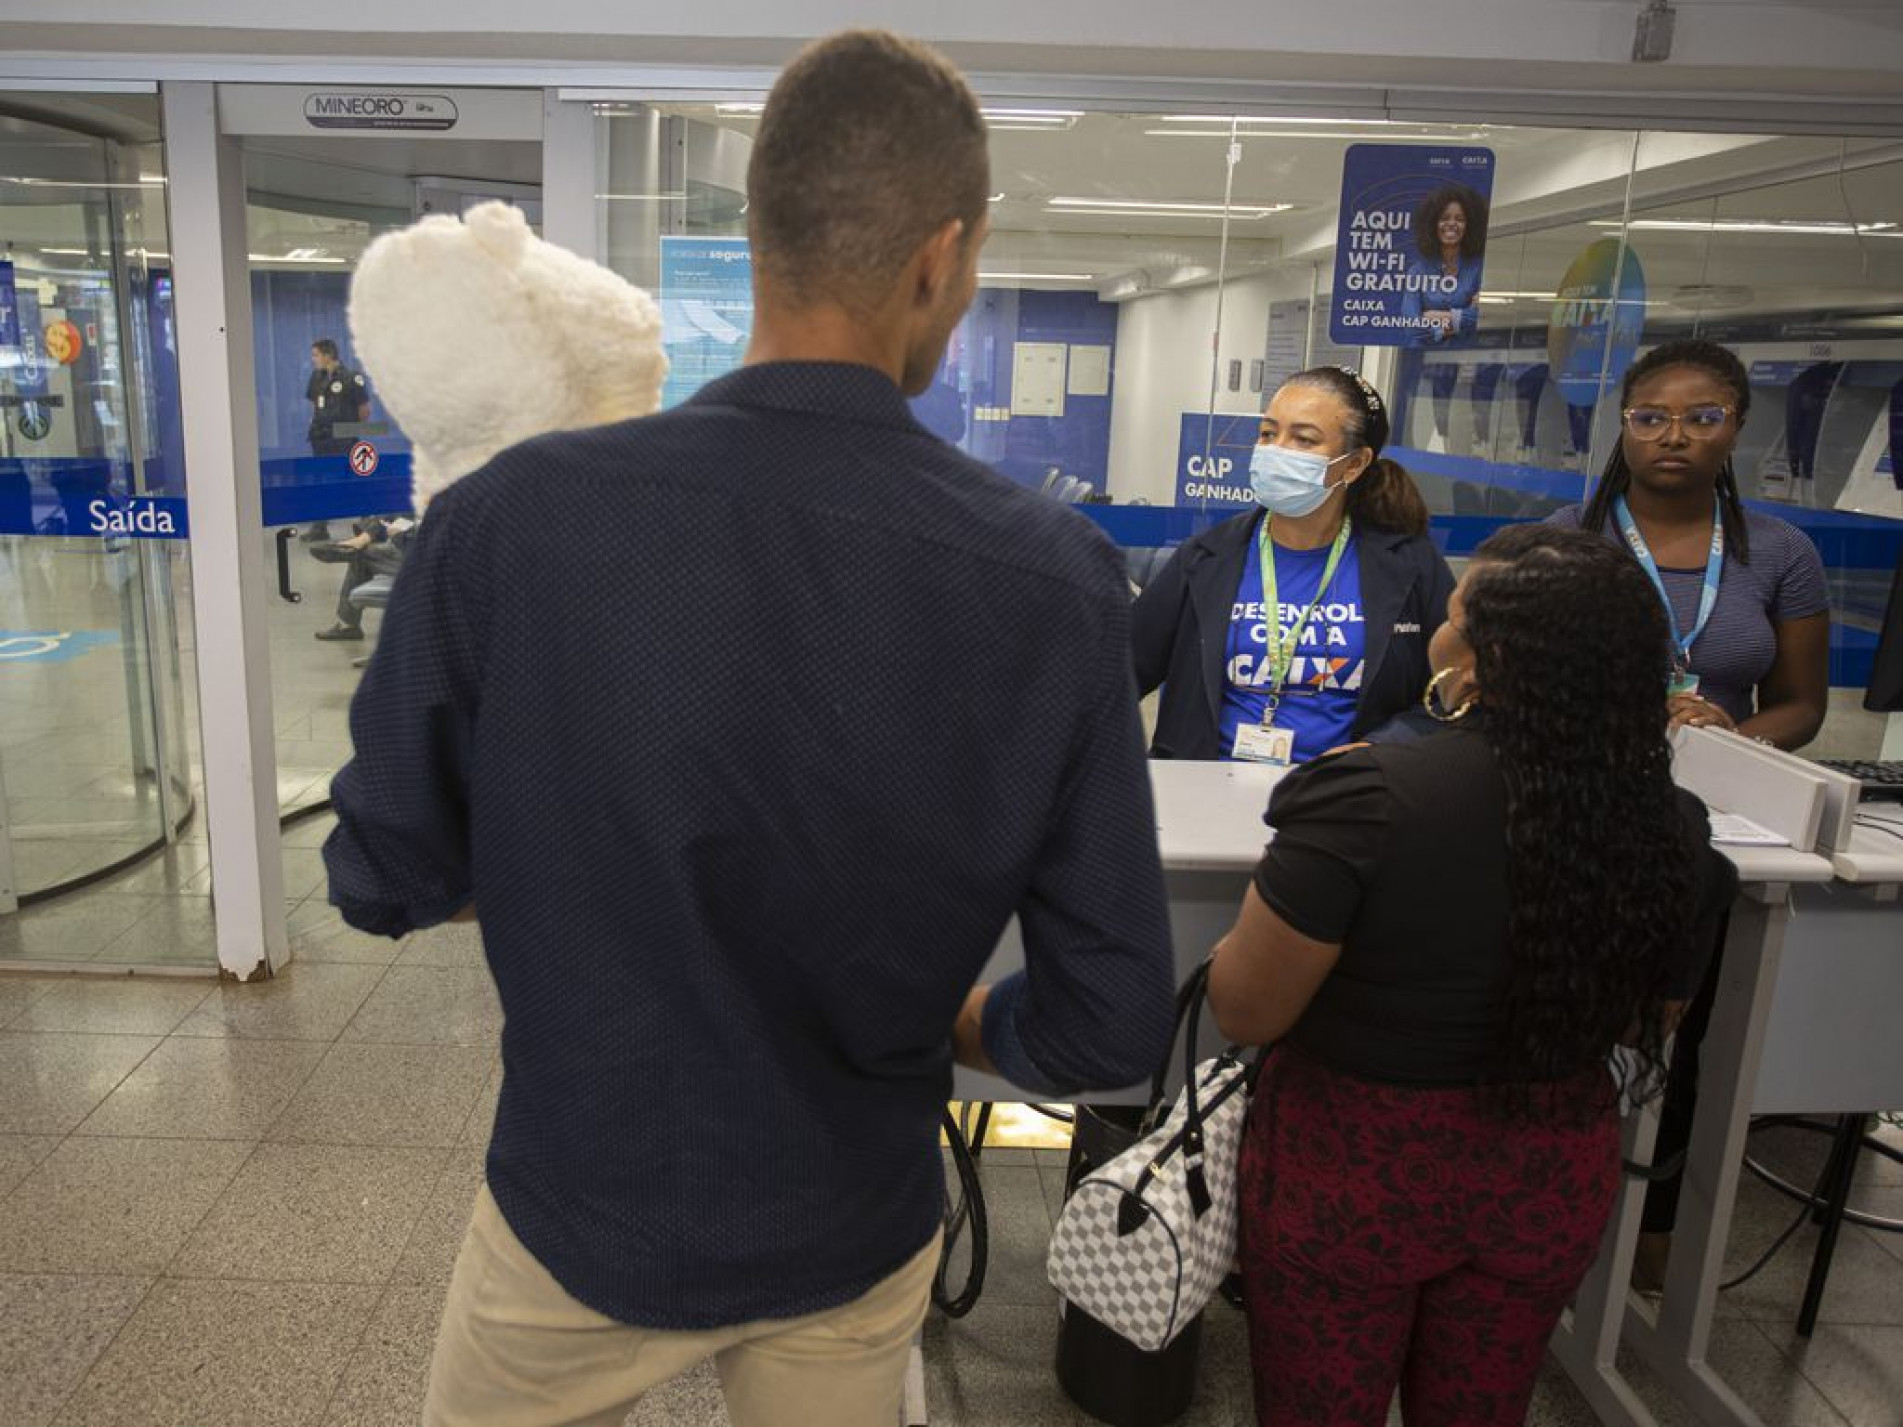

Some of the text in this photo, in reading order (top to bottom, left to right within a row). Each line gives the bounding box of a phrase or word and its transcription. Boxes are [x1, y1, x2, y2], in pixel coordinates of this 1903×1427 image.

[315, 98, 404, 115] MINEORO
[1351, 210, 1412, 231] AQUI
[1350, 231, 1393, 250] TEM
[1349, 252, 1406, 271] WI-FI
[1346, 273, 1458, 293] GRATUITO
[1343, 299, 1385, 311] CAIXA
[1342, 315, 1450, 328] CAP GANHADOR
[1187, 455, 1233, 478] CAP
[1185, 482, 1261, 502] GANHAD
[89, 500, 175, 533] Saída
[1231, 601, 1366, 623] DESENROL
[1326, 626, 1348, 646] A
[1227, 653, 1365, 691] CAIXA
